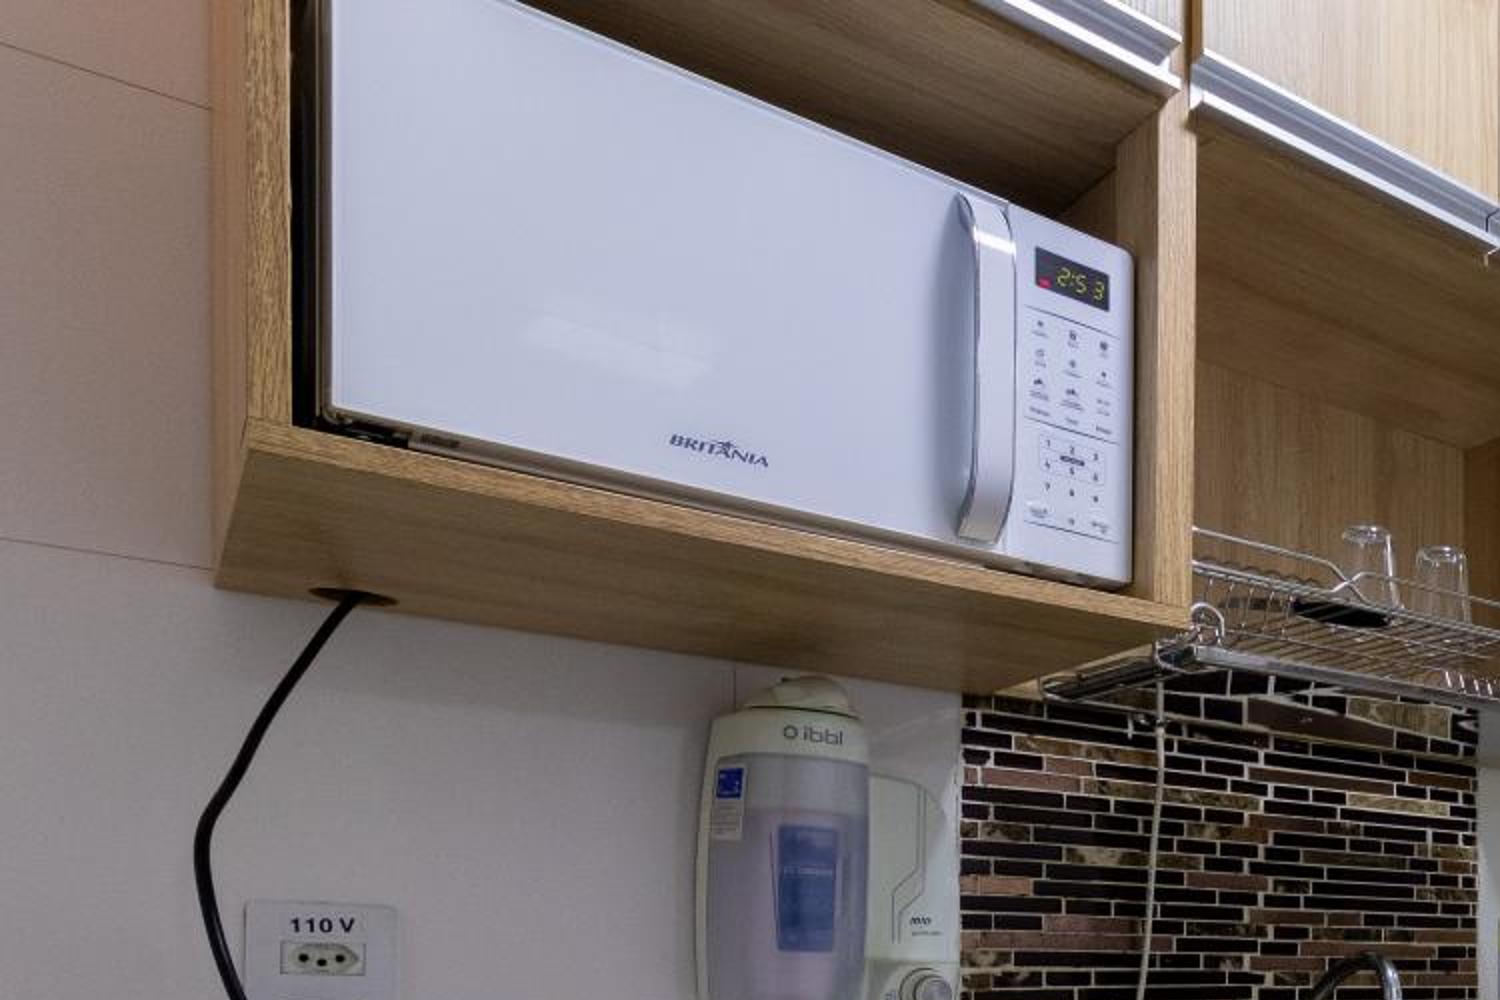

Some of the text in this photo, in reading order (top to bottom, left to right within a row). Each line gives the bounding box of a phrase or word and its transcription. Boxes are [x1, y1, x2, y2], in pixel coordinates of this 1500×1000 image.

[1057, 266, 1105, 301] 2:53
[290, 917, 355, 933] 110 V
